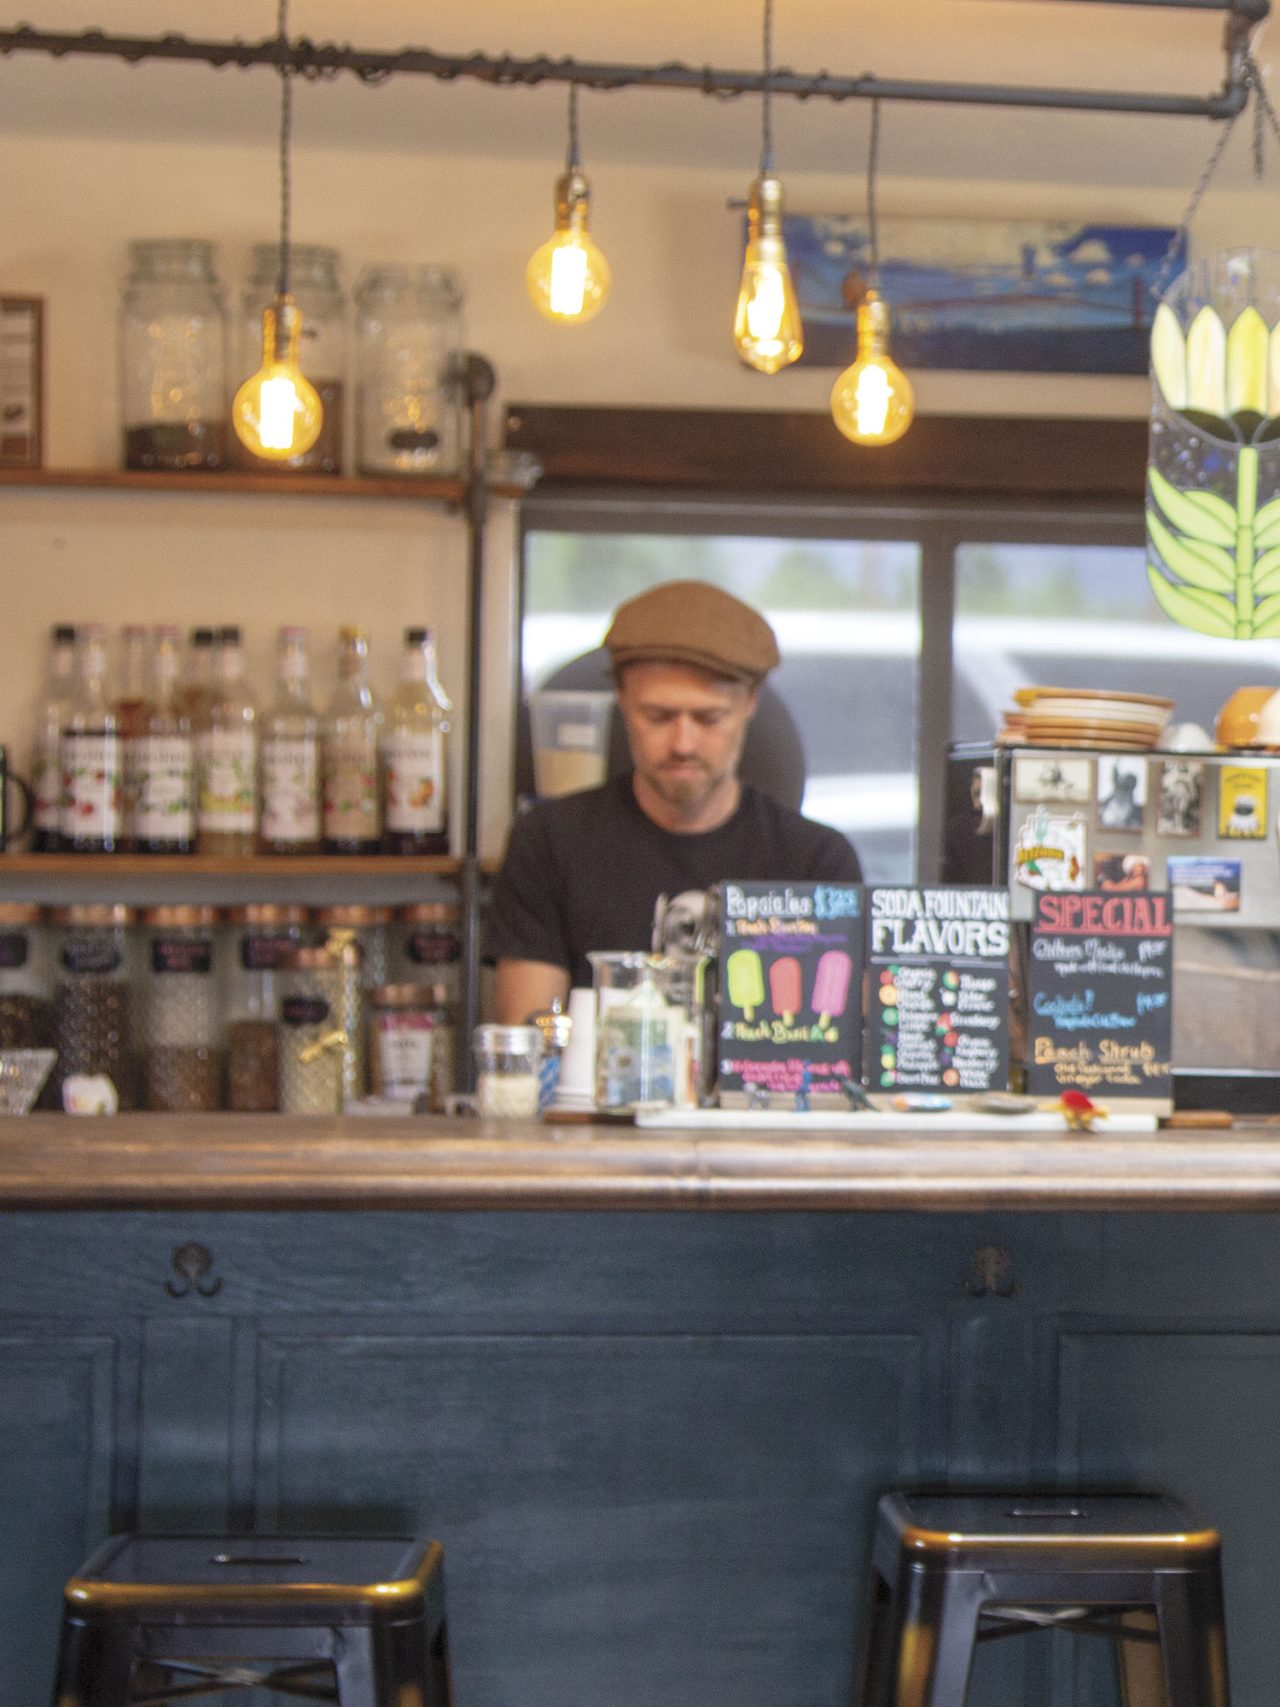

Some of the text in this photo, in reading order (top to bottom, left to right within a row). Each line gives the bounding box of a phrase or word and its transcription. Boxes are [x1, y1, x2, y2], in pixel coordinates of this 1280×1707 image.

[872, 889, 1009, 921] SODA FOUNTAIN
[1038, 894, 1173, 934] SPECIAL
[872, 919, 1010, 957] FLAVORS
[1098, 1039, 1156, 1063] Shrub
